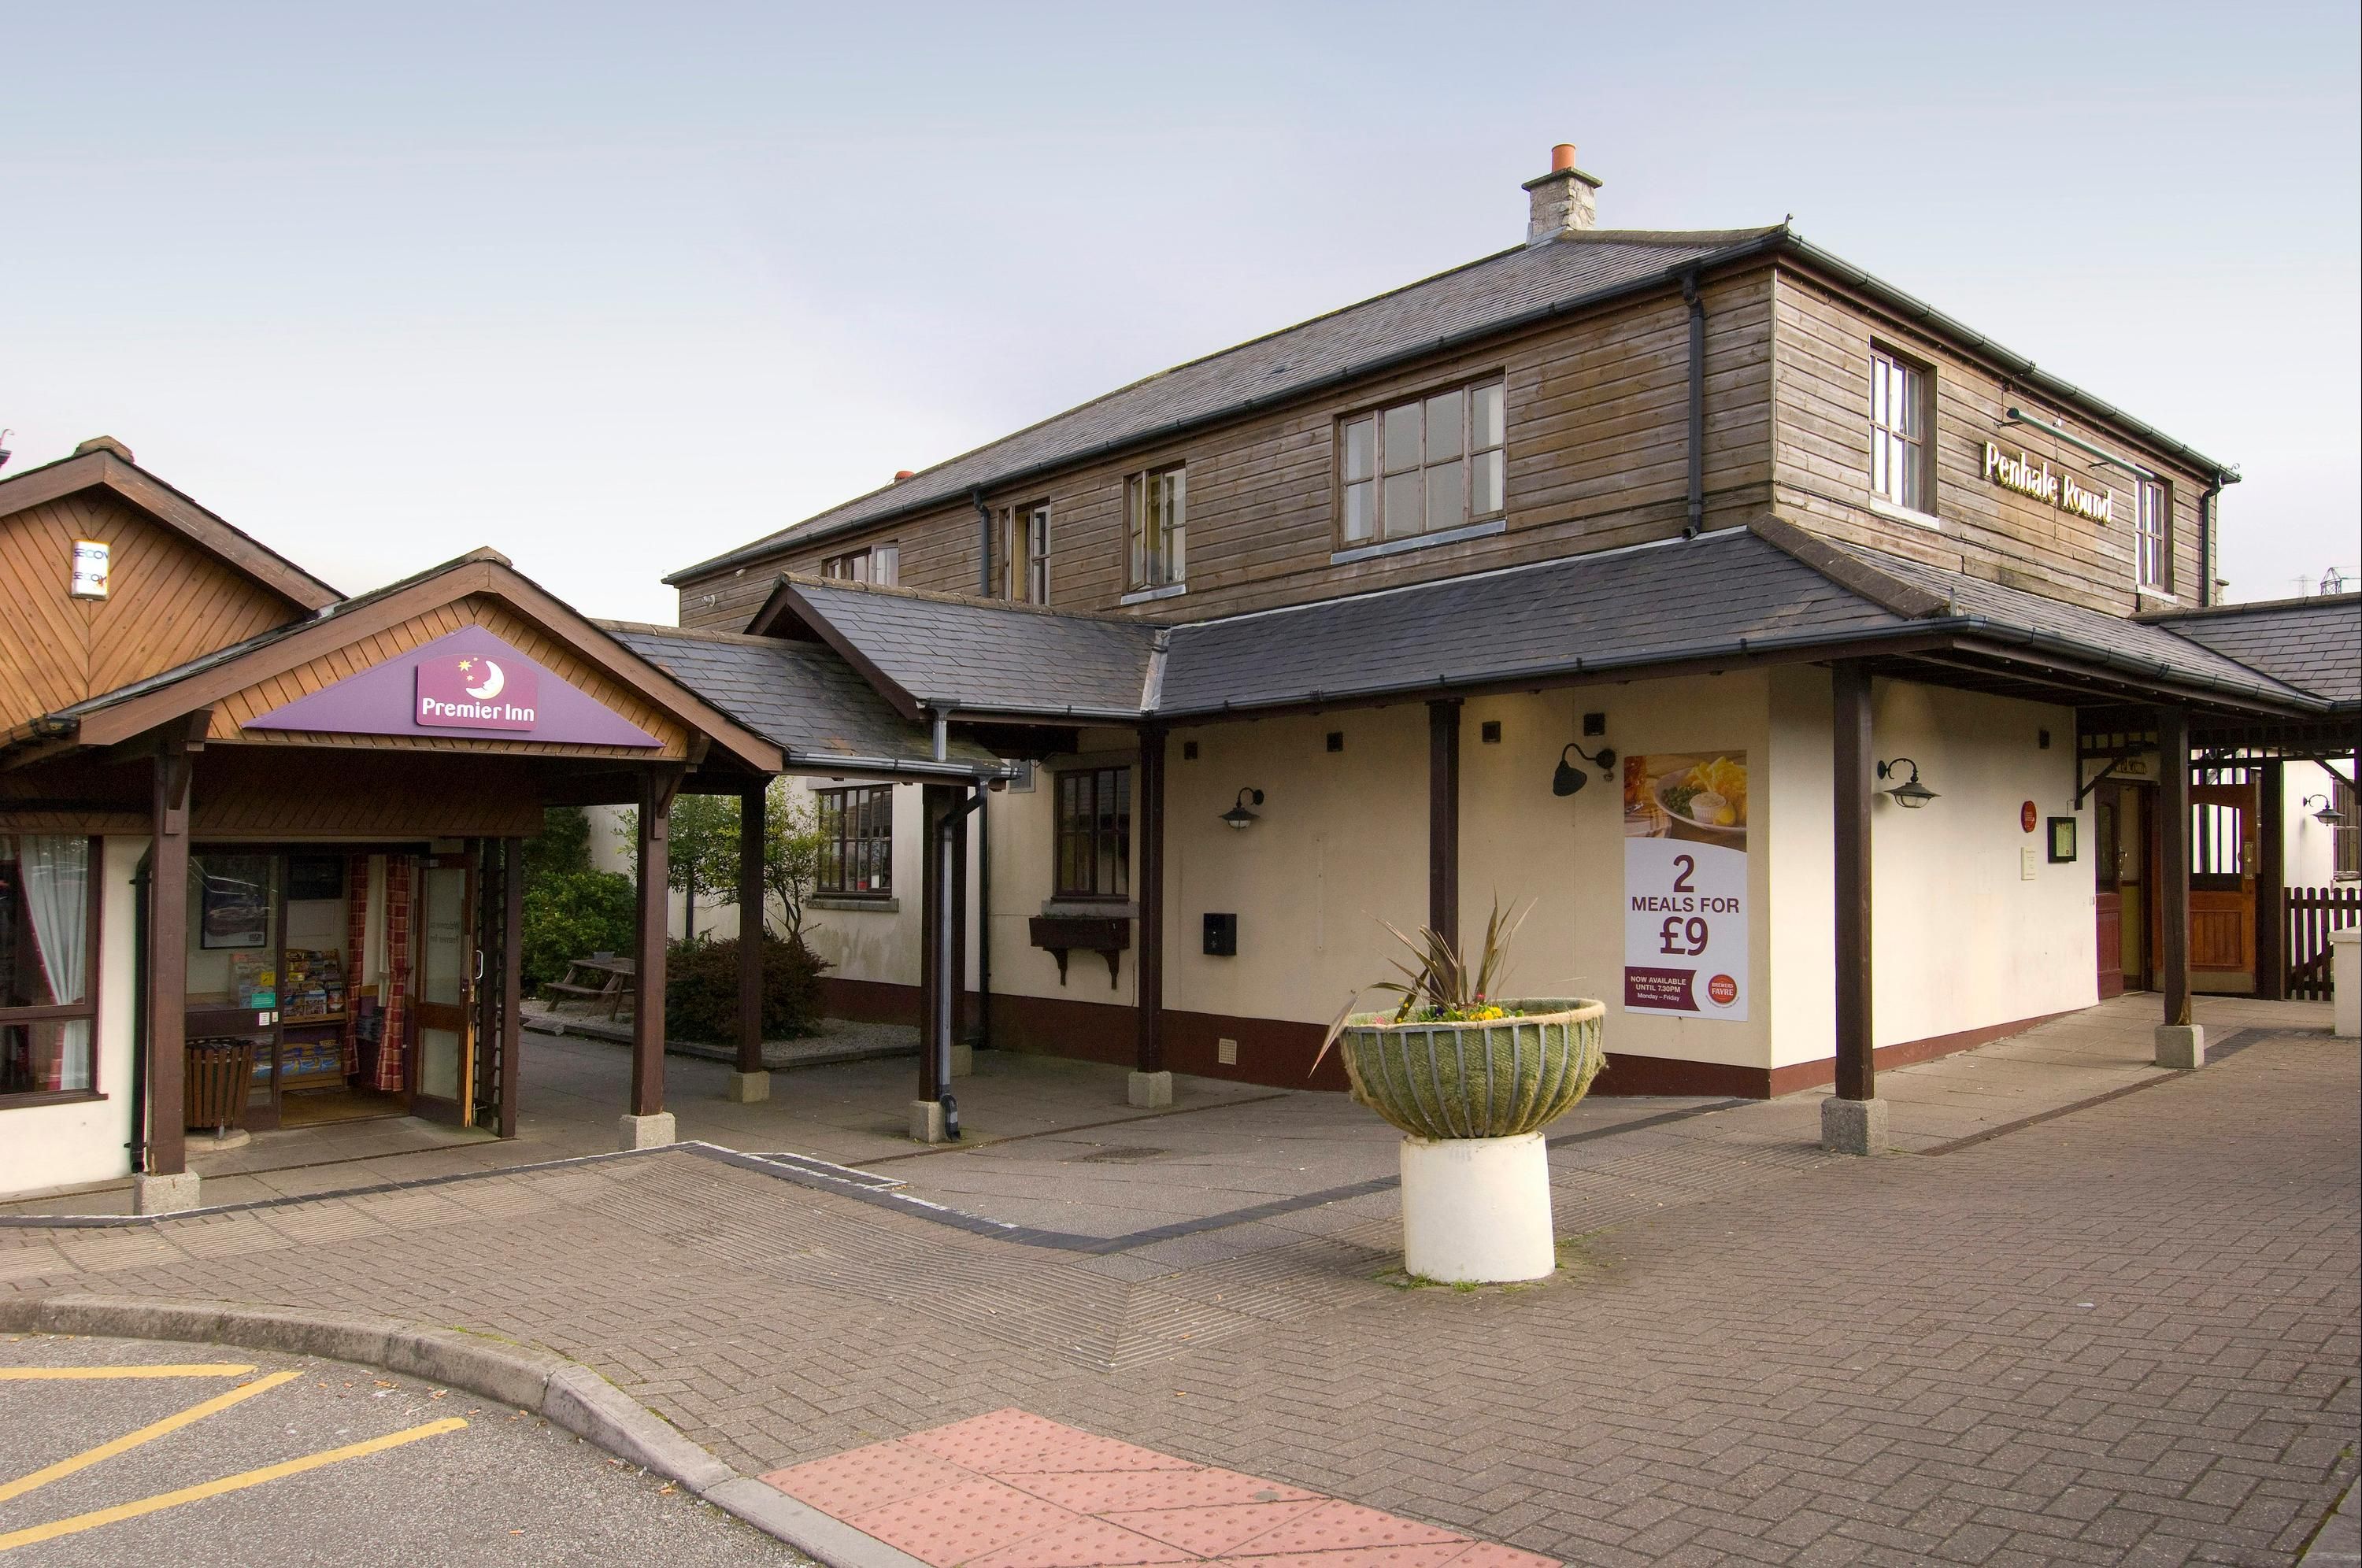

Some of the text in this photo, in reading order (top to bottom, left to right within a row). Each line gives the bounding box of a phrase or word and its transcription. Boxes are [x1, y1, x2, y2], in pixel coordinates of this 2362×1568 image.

[1983, 441, 2112, 524] Penhale Round
[422, 697, 535, 722] Premier Inn
[1673, 854, 1694, 893] 2
[1631, 896, 1739, 913] MEALS FOR
[1659, 915, 1709, 956] £9
[1649, 977, 1686, 986] AVAILABLE
